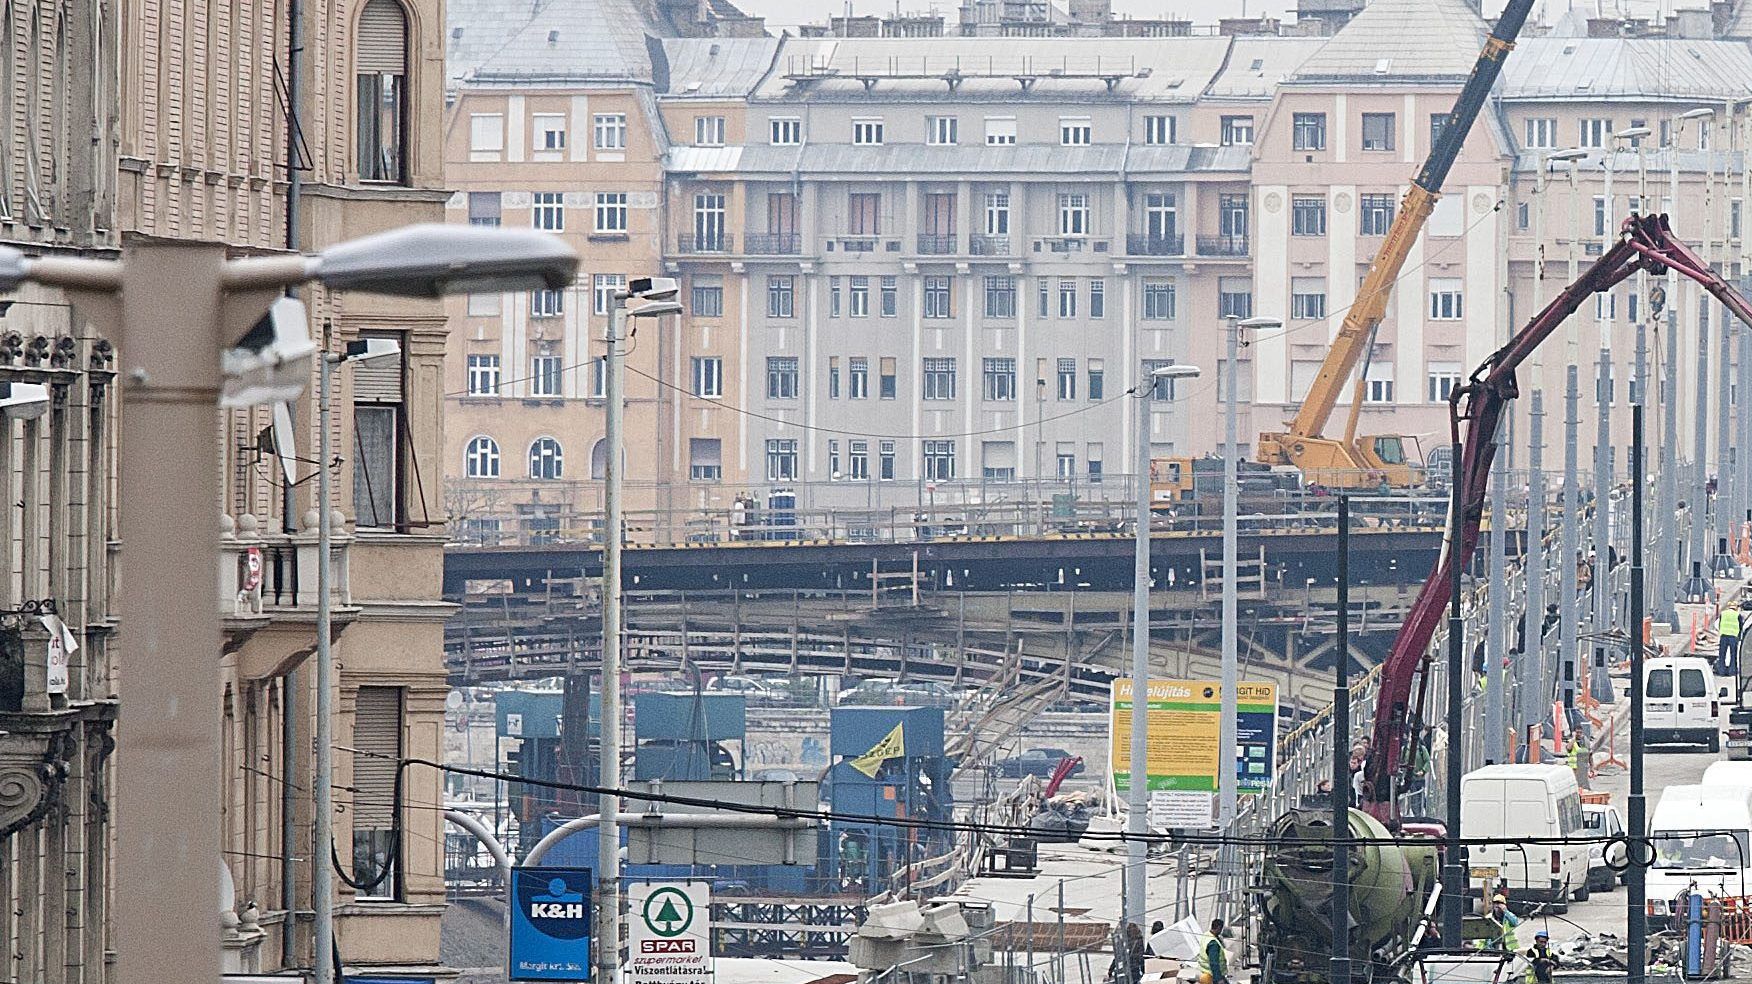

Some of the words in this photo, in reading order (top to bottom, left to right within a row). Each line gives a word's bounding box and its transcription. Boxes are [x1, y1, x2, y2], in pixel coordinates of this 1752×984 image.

[531, 904, 583, 918] K&H
[642, 941, 694, 952] SPAR
[634, 955, 703, 965] szupermarket
[634, 965, 707, 976] Viszontlátásra!
